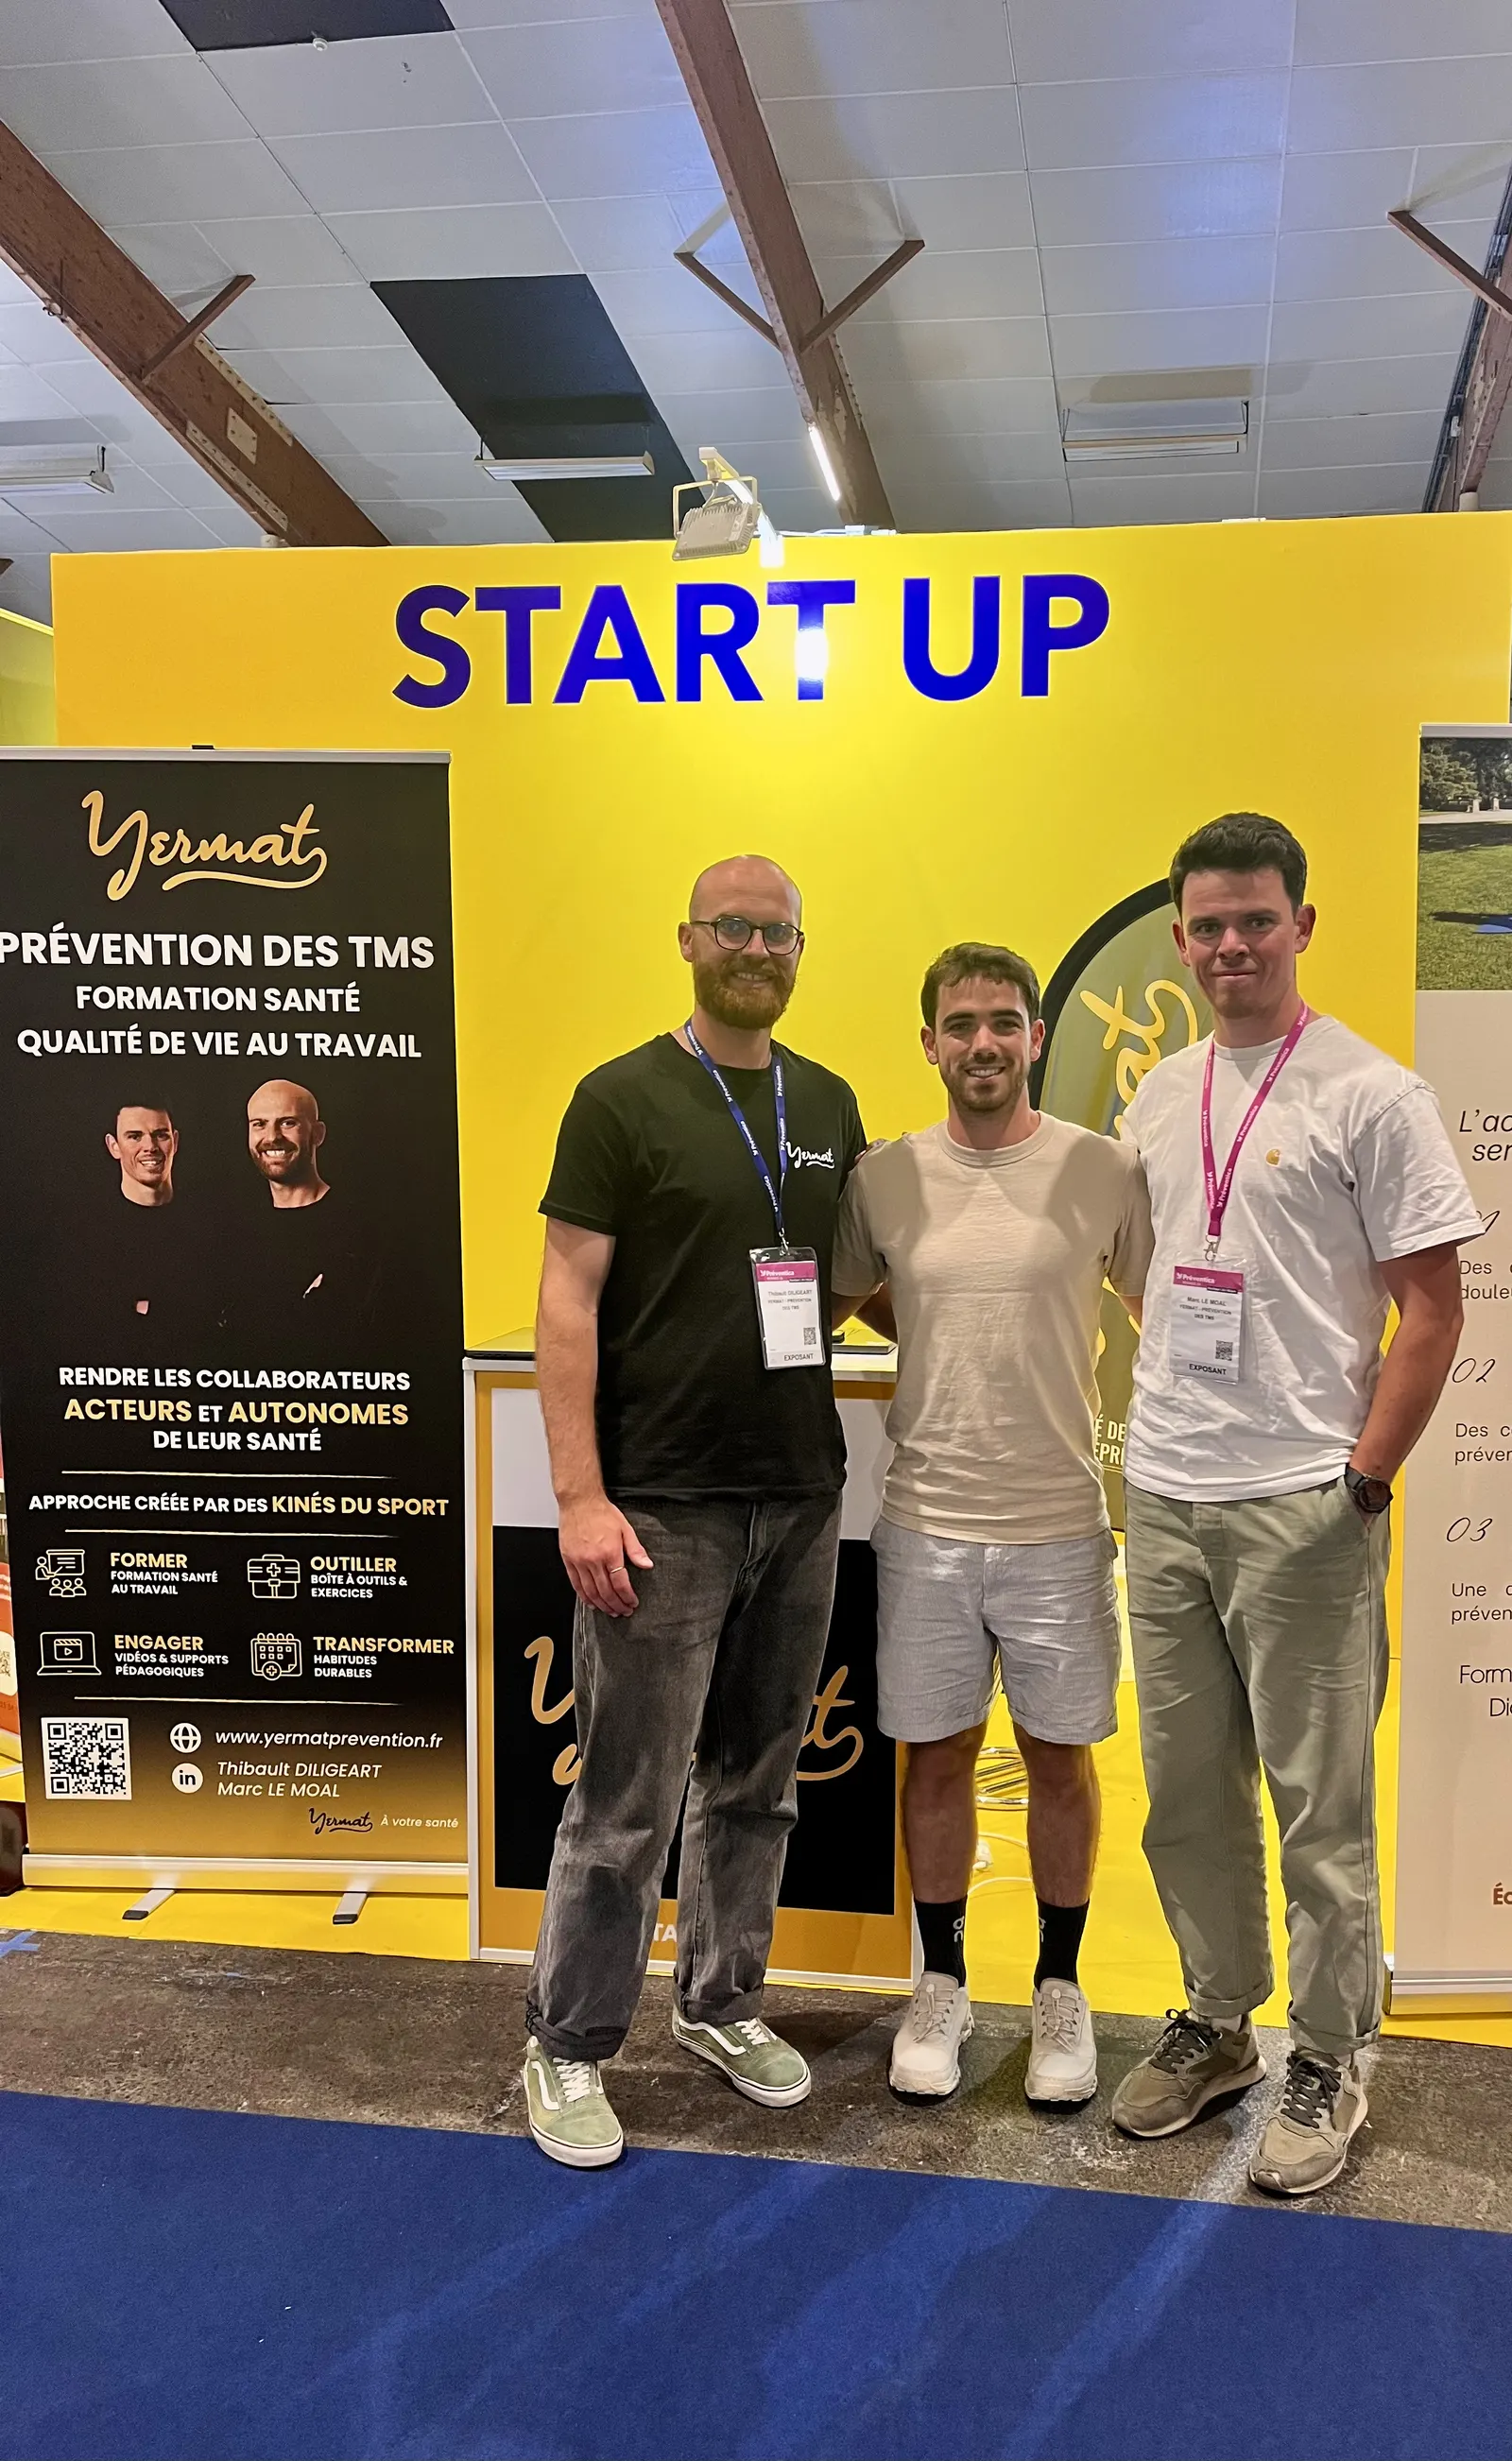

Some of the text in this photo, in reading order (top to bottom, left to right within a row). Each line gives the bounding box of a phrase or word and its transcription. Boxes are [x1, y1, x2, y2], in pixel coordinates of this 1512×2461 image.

[391, 574, 1110, 709] START UP
[81, 790, 328, 901] Yermat
[0, 922, 435, 969] PRÉVENTION DES TMS
[77, 981, 360, 1012] FORMATION SANTÉ
[17, 1023, 422, 1058] QUALITÉ DE VIE AU TRAVAIL
[1460, 1260, 1492, 1275] Des
[1461, 1283, 1512, 1299] doule
[783, 1353, 815, 1362] EXPOSANT
[1189, 1363, 1228, 1375] EXPOSANT
[1452, 1357, 1496, 1383] 02
[59, 1367, 411, 1390] RENDRE LES COLLABORATEURS
[64, 1399, 409, 1424] ACTEURS ET AUTONOMES
[1455, 1423, 1488, 1437] Des
[153, 1428, 322, 1451] DE LEUR SANTÉ
[28, 1491, 449, 1516] APPROCHE CRÉÉE PAR DES KINÉS DU SPORT
[1446, 1517, 1493, 1542] 03
[111, 1552, 188, 1569] FORMER
[310, 1556, 397, 1573] OUTILLER
[111, 1571, 218, 1583] FORMATION SANTÉ
[311, 1573, 407, 1586] BOÎTE À OUTILS &
[112, 1584, 179, 1595] AU TRAVAIL
[311, 1588, 373, 1598] EXERCICES
[1452, 1583, 1486, 1597] Une
[114, 1634, 204, 1651] ENGAGER
[313, 1636, 455, 1654] TRANSFORMER
[115, 1651, 229, 1665] VIDÉOS & SUPPORTS
[314, 1655, 377, 1665] HABITUDES
[115, 1663, 204, 1678] PÉDAGOGIQUES
[314, 1667, 372, 1678] DURABLES
[215, 1731, 443, 1750] www.yermatprevention.fr
[217, 1762, 382, 1780] Thibault DILIGEART
[217, 1782, 340, 1798] Marc LE MOAL
[380, 1814, 459, 1830] À votre santé
